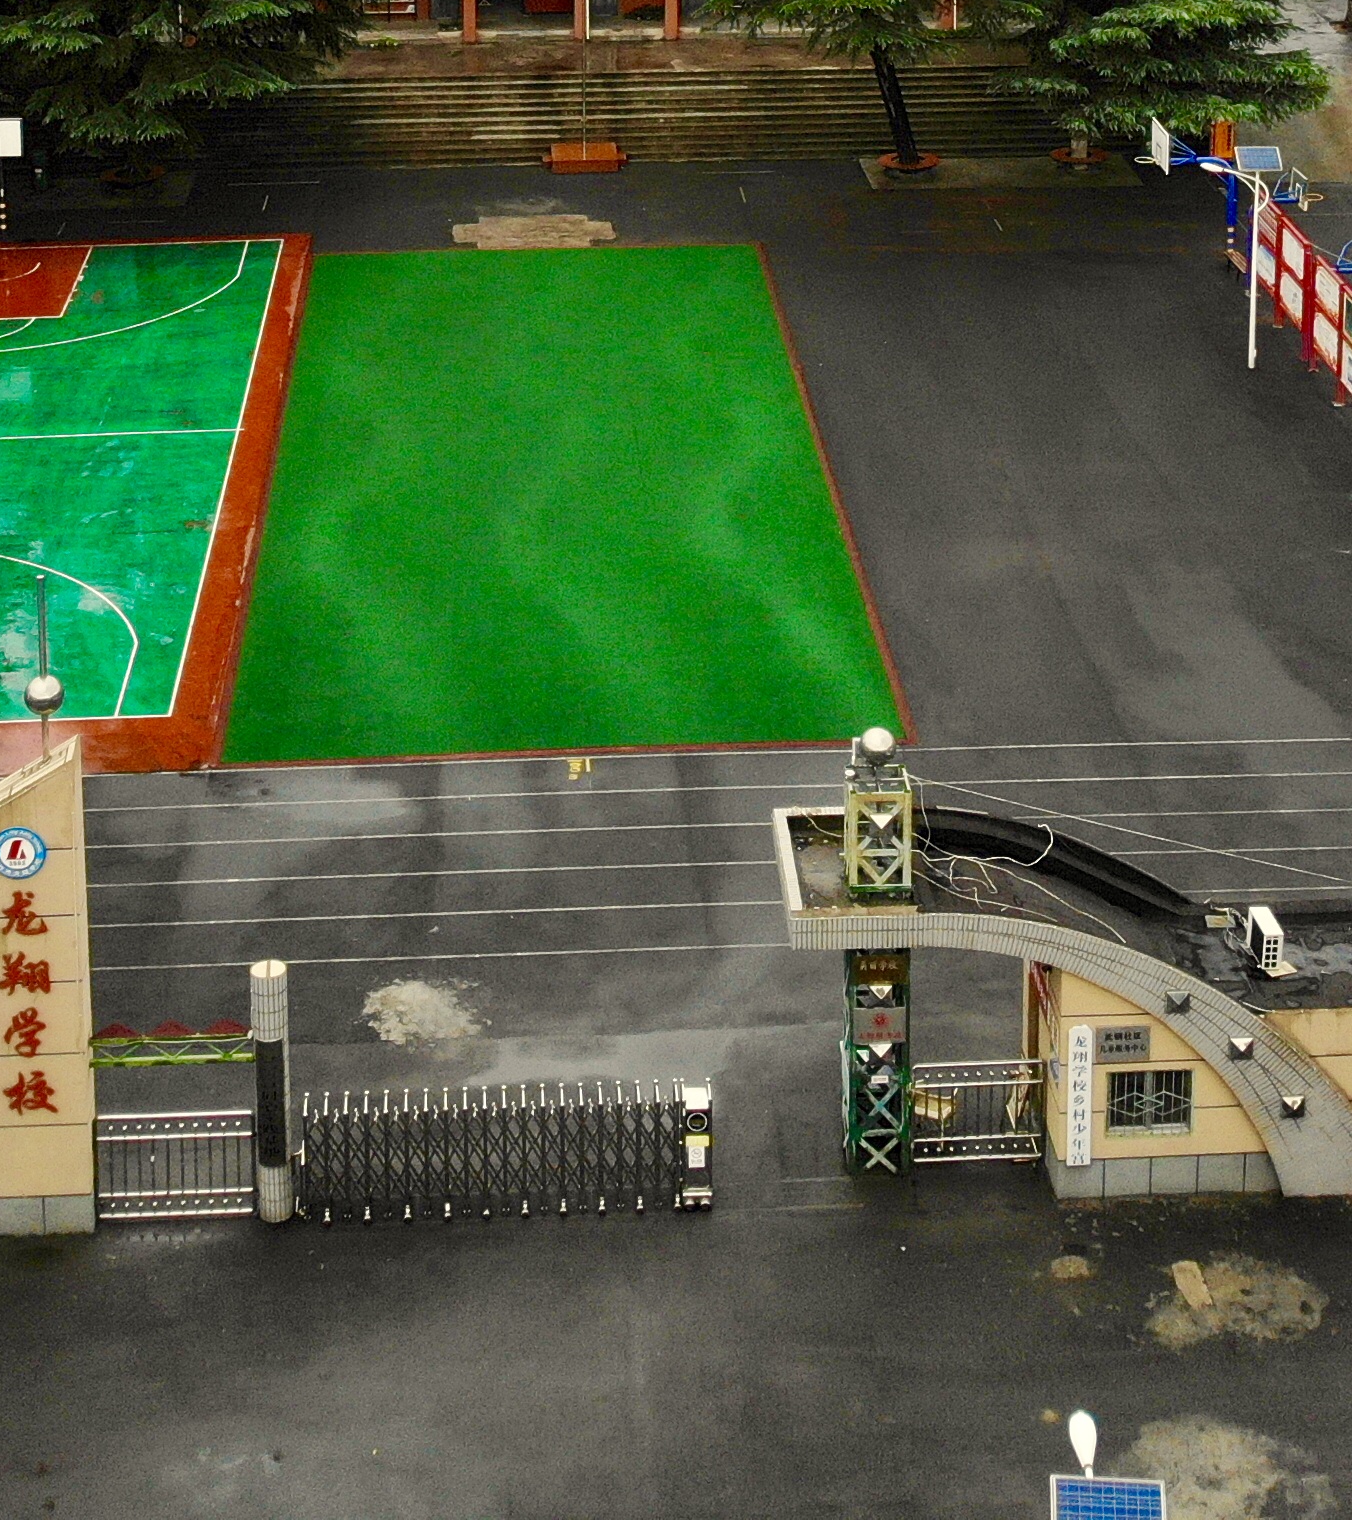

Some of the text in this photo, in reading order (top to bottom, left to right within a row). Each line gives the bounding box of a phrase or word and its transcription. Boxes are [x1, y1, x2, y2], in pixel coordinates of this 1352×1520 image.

[1072, 1035, 1089, 1165] 龙翔学校乡村少年宫
